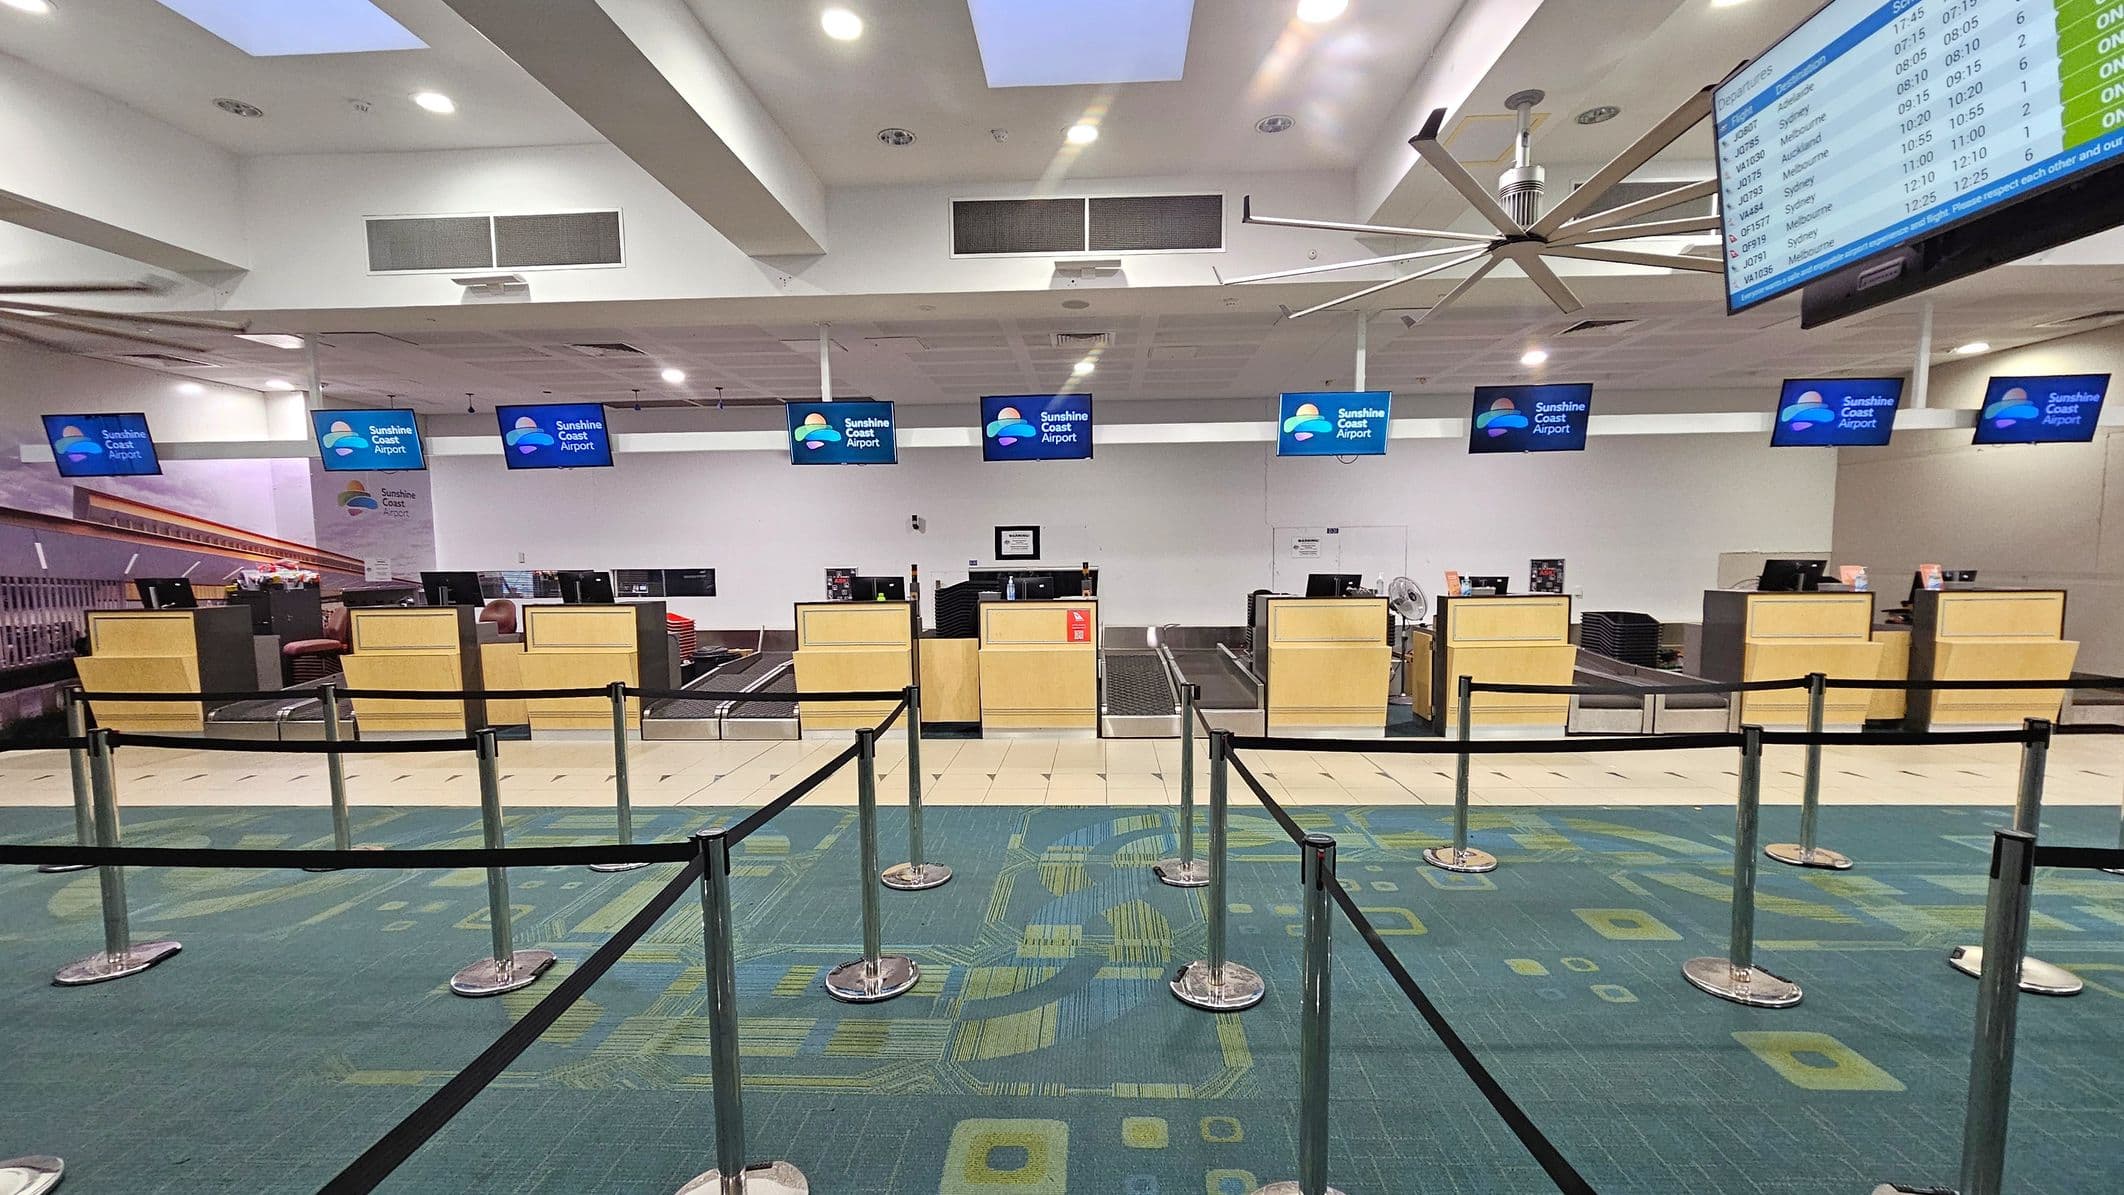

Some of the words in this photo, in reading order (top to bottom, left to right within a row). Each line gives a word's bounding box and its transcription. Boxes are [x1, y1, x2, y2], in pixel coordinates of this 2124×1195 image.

[1778, 83, 1815, 111] Adelaide
[1893, 7, 1925, 34] 17:45
[1719, 65, 1773, 111] Departures
[1731, 106, 1753, 127] Flight
[1776, 55, 1826, 95] Destination
[1735, 135, 1760, 158] JQ785
[1779, 104, 1810, 130] Sydney
[1894, 27, 1926, 55] 07:15
[1736, 149, 1766, 173] VA1030
[1780, 112, 1827, 146] Melbourne
[1895, 48, 1927, 75] 08:05
[1943, 15, 1979, 46] 08:05
[1737, 169, 1762, 190] JQ175
[1782, 132, 1822, 162] Auckland
[1896, 69, 1929, 95] 08:10
[1945, 37, 1980, 67] 08:10
[2016, 11, 2025, 25] 6
[1739, 202, 1764, 221] VA484
[1784, 175, 1815, 198] Sydney
[1900, 110, 1931, 134] 10:20
[1948, 81, 1983, 109] 10:20
[2019, 56, 2028, 70] 6
[2096, 4, 2124, 29] ON
[1738, 185, 1764, 206] JQ793
[1782, 149, 1829, 181] Melbourne
[1898, 89, 1930, 115] 09:15
[1946, 59, 1982, 88] 09:15
[2017, 34, 2026, 48] 2
[1741, 215, 1770, 237] QF1577
[1785, 193, 1816, 215] Sydney
[1901, 130, 1933, 154] 10:55
[1950, 102, 1984, 129] 10:55
[2021, 80, 2027, 93] 1
[2098, 29, 2124, 54] ON
[1742, 234, 1767, 253] QF919
[1786, 203, 1833, 232] Melbourne
[1903, 151, 1934, 174] 11:00
[1951, 125, 1986, 150] 11:00
[2022, 102, 2031, 117] 2
[1743, 251, 1767, 269] JQ791
[1787, 228, 1818, 248] Sydney
[1904, 171, 1935, 194] 12:10
[1953, 146, 1987, 172] 12:10
[2024, 126, 2030, 138] 1
[1800, 263, 1813, 275] and
[1868, 225, 1909, 248] experience
[1910, 216, 1927, 231] and
[1952, 193, 1983, 213] Please
[1983, 178, 2020, 201] respect
[2021, 166, 2047, 185] each
[2048, 154, 2077, 174] other
[2079, 143, 2101, 161] and
[2103, 135, 2124, 152] our
[1744, 265, 1774, 284] VA1036
[1788, 238, 1835, 265] Melbourne
[1905, 191, 1937, 214] 12:25
[1954, 168, 1989, 192] 12:25
[2025, 148, 2033, 161] 6
[1843, 395, 1894, 407] Sunshine
[2048, 391, 2100, 403] Sunshine
[1338, 407, 1385, 418] Sunshine
[1535, 401, 1586, 412] Sunshine
[1841, 407, 1874, 418] Coast
[2045, 403, 2079, 414] Coast
[1040, 410, 1088, 422] Sunshine
[1534, 413, 1567, 423] Coast
[2041, 415, 2082, 427] Airport
[555, 419, 602, 431] Sunshine
[844, 417, 890, 428] Sunshine
[1041, 422, 1072, 432] Coast
[1337, 418, 1368, 428] Coast
[1838, 418, 1877, 430] Airport
[101, 429, 147, 439] Sunshine
[369, 425, 412, 436] Sunshine
[845, 428, 875, 438] Coast
[1336, 429, 1373, 440] Airport
[1532, 423, 1571, 435] Airport
[371, 435, 400, 445] Coast
[558, 430, 588, 441] Coast
[1041, 432, 1077, 445] Airport
[105, 439, 135, 450] Coast
[560, 441, 595, 453] Airport
[846, 437, 881, 449] Airport
[109, 450, 142, 461] Airport
[374, 444, 407, 456] Airport
[381, 487, 416, 500] Sunshine
[382, 497, 405, 508] Coast
[383, 508, 410, 519] Airport
